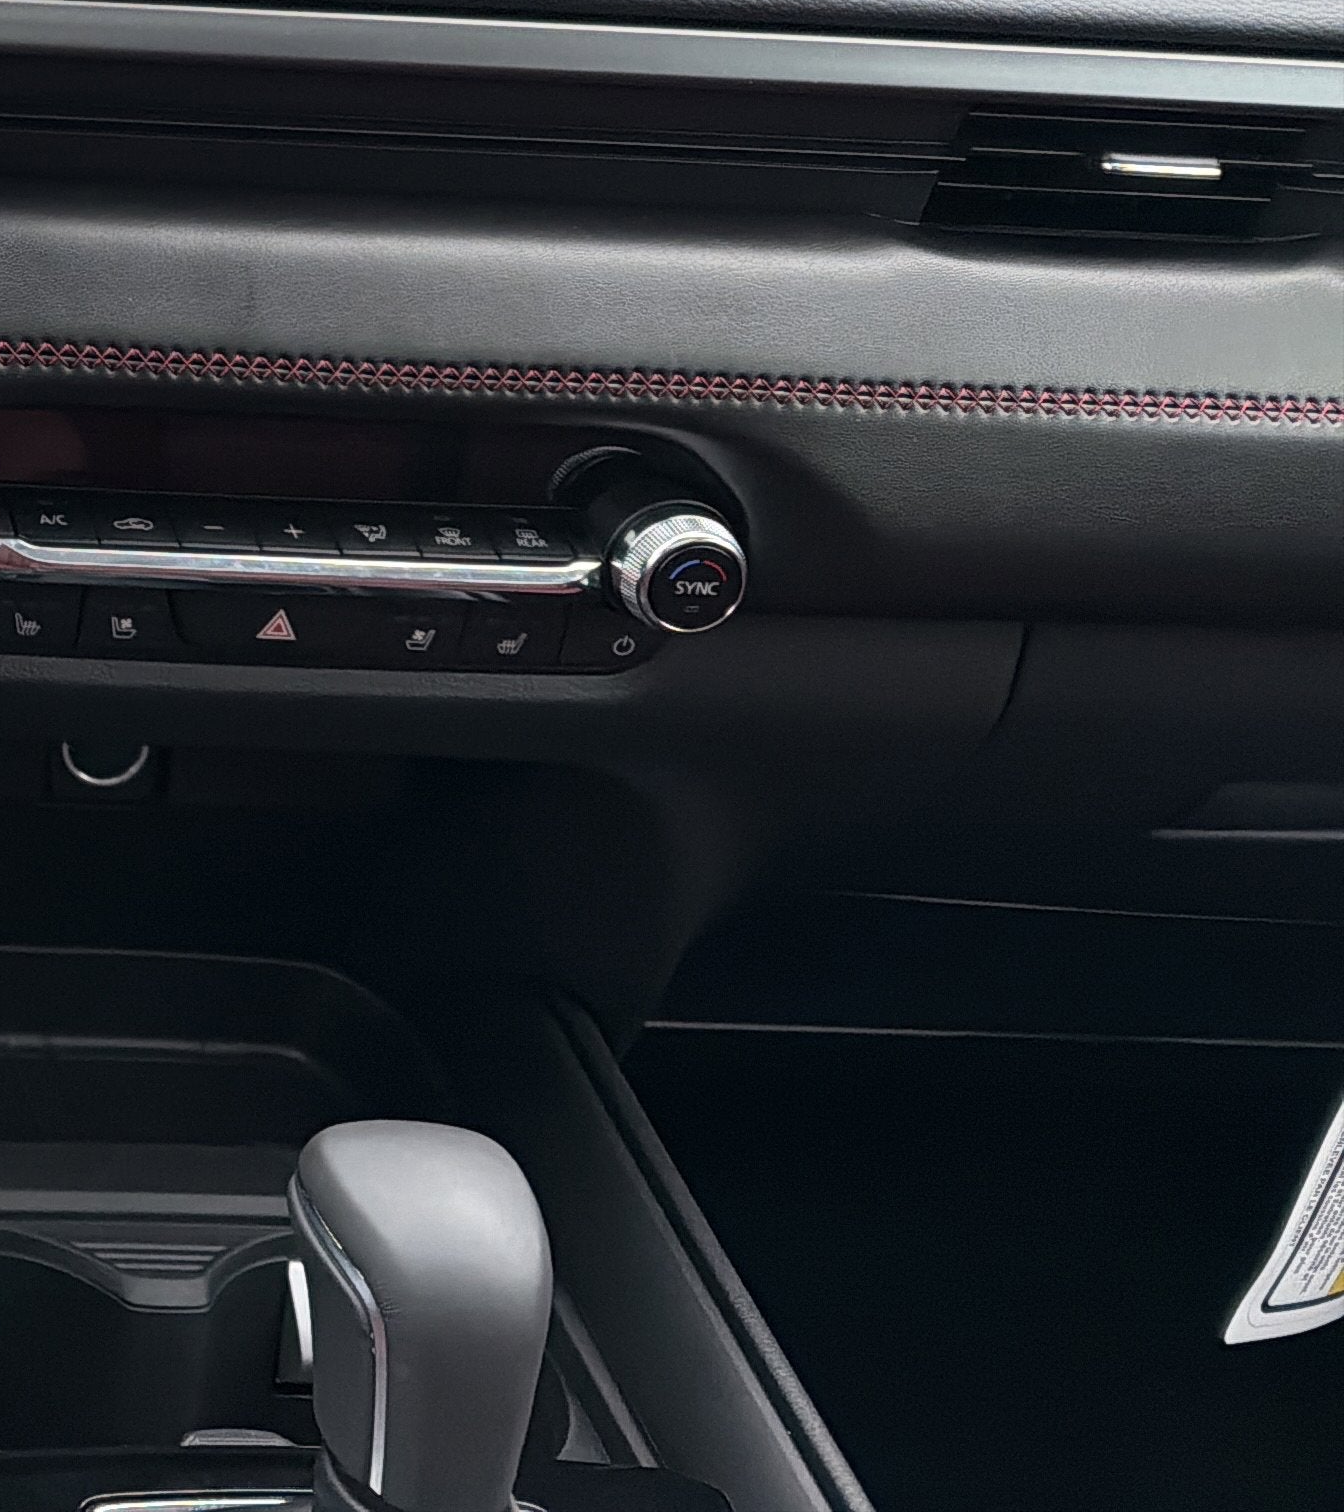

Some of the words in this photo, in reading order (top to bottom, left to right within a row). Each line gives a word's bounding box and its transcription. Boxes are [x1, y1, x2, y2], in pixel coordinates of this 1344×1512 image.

[39, 513, 68, 526] A/C
[434, 535, 472, 547] FRONT
[515, 537, 548, 549] REAR
[673, 580, 721, 596] SYNC
